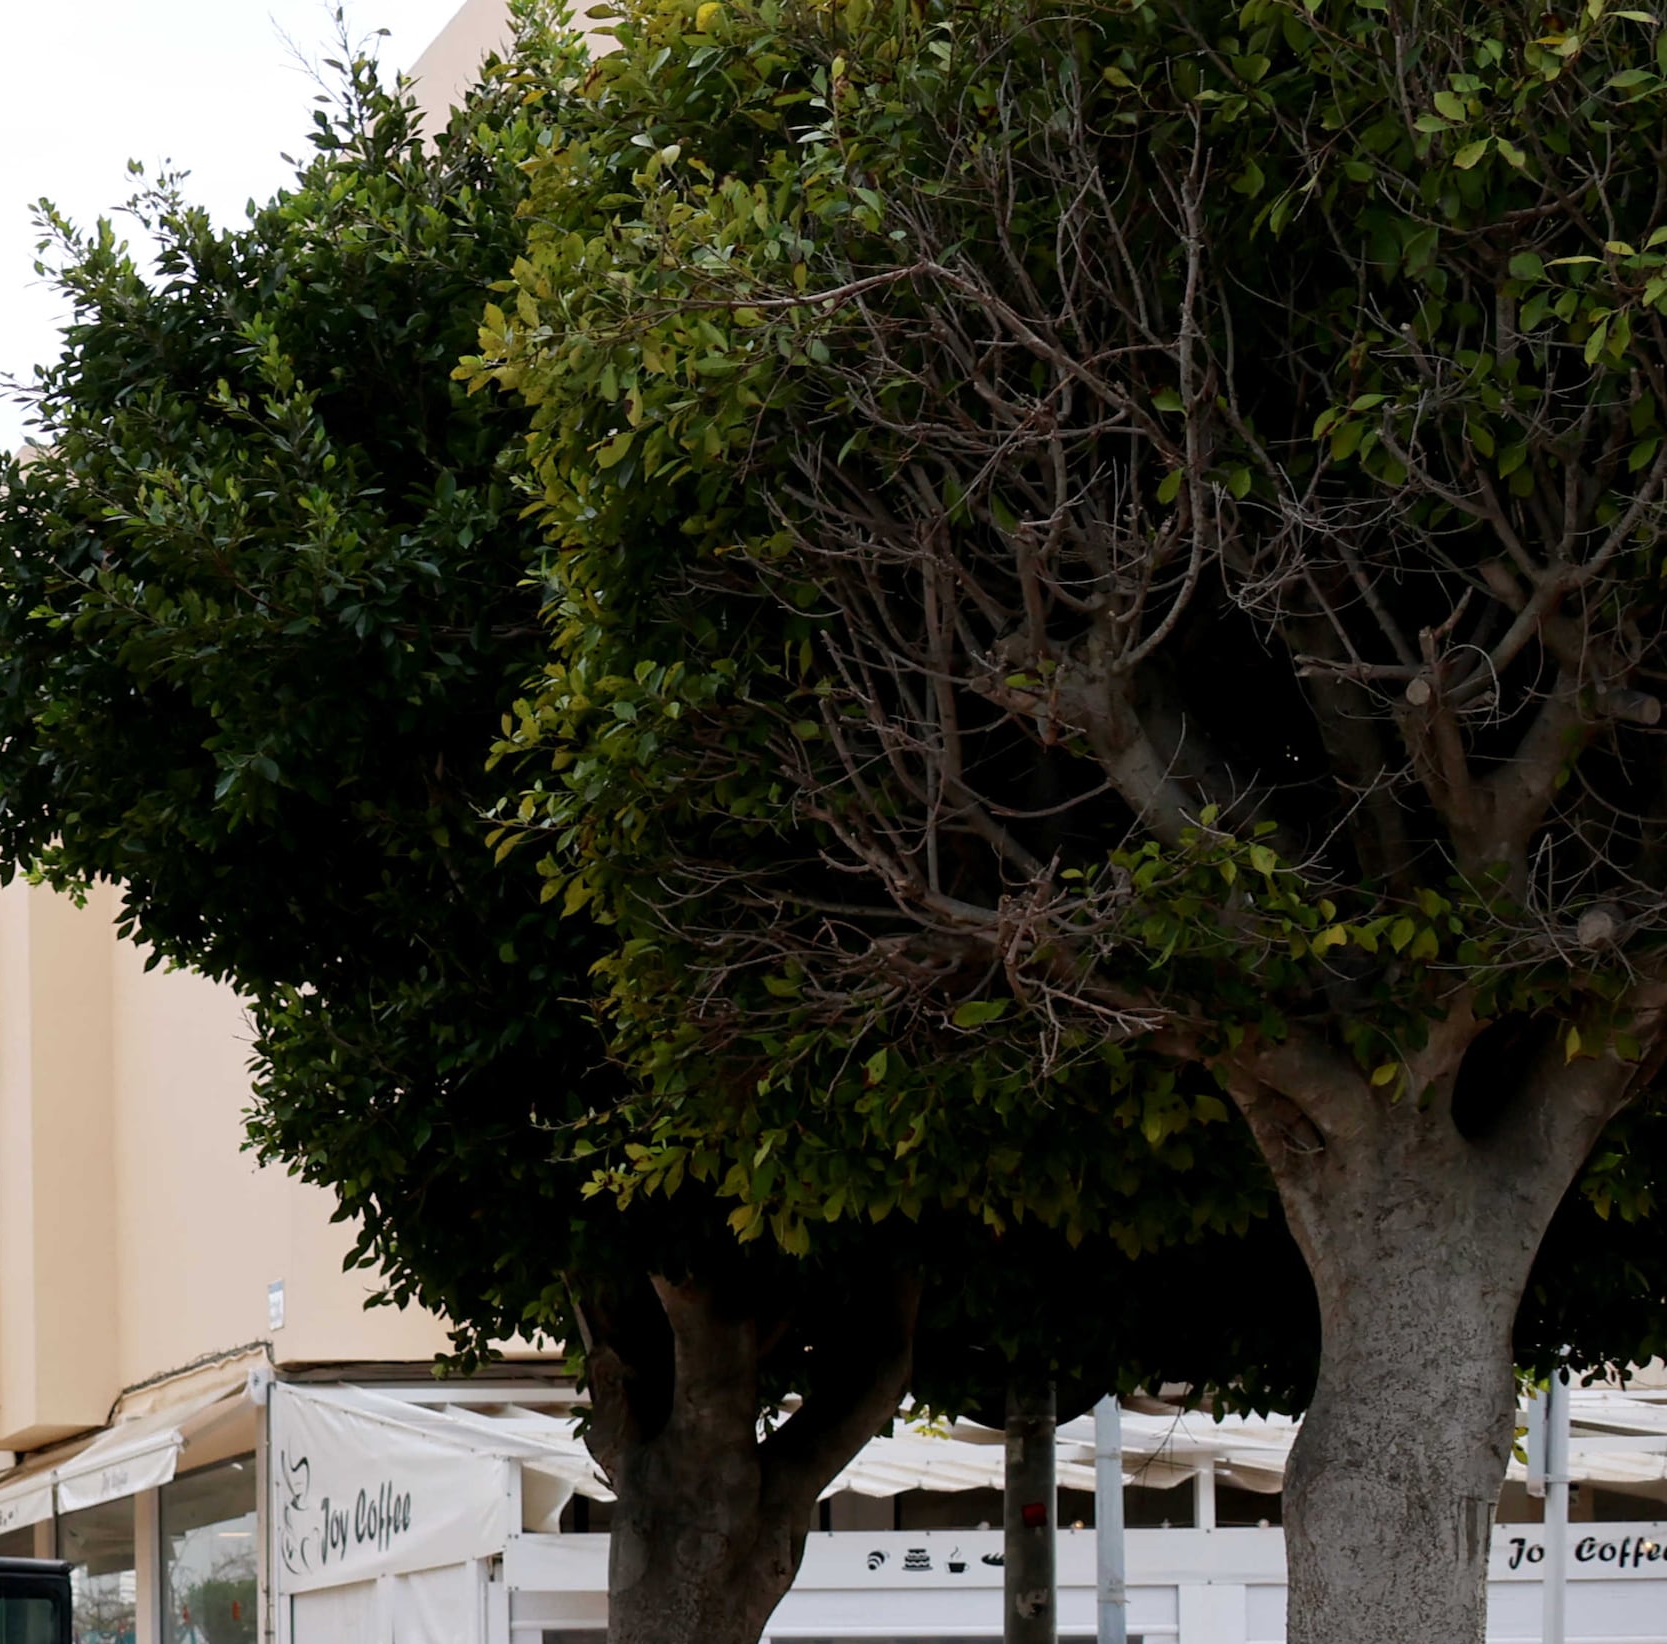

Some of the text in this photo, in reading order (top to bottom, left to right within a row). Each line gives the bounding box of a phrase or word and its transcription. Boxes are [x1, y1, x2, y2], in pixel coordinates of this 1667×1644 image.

[321, 1480, 411, 1566] Joy Coffee
[1509, 1536, 1667, 1570] Jo Coffe
